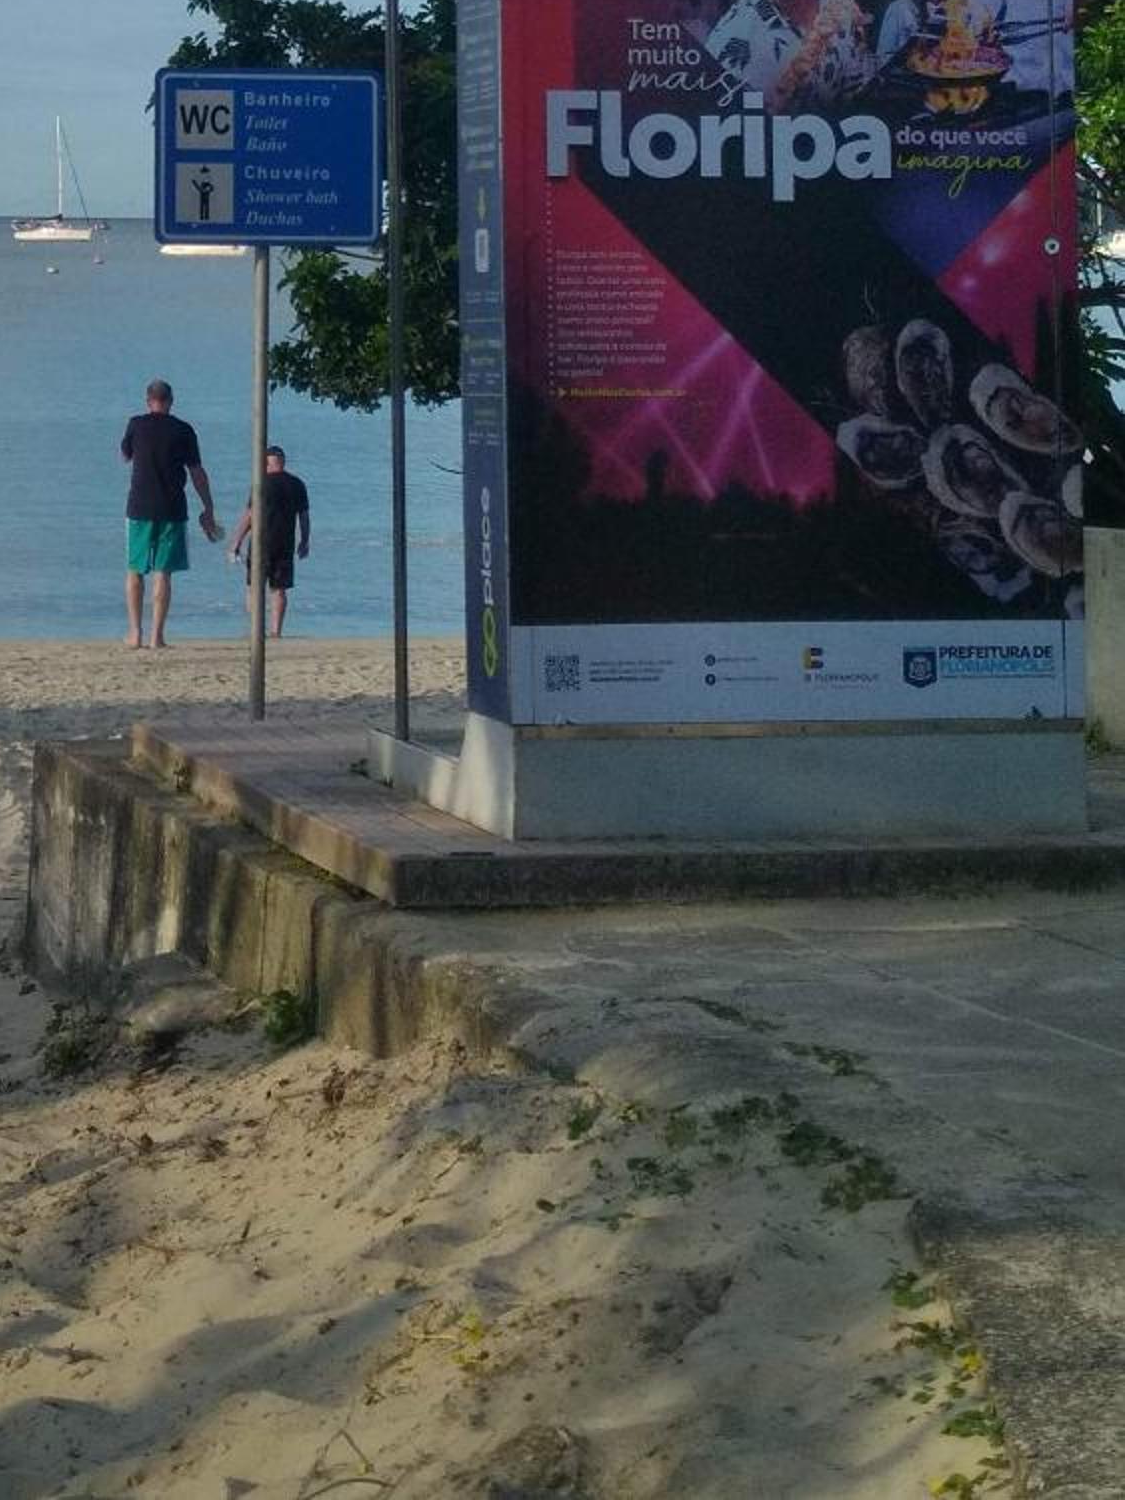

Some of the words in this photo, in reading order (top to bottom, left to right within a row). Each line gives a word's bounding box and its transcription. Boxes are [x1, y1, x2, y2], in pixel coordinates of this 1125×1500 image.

[628, 19, 681, 40] Tem
[628, 44, 701, 65] muito
[628, 70, 747, 107] mais
[244, 92, 331, 108] Banheiro
[180, 104, 231, 135] WC
[546, 90, 892, 202] Floripa
[895, 125, 925, 145] do
[930, 129, 972, 149] que
[244, 165, 331, 180] Chuveiro
[896, 153, 1032, 197] imagina
[245, 189, 303, 204] Shower
[939, 645, 1030, 659] PREFEITURA
[1032, 645, 1053, 658] DE
